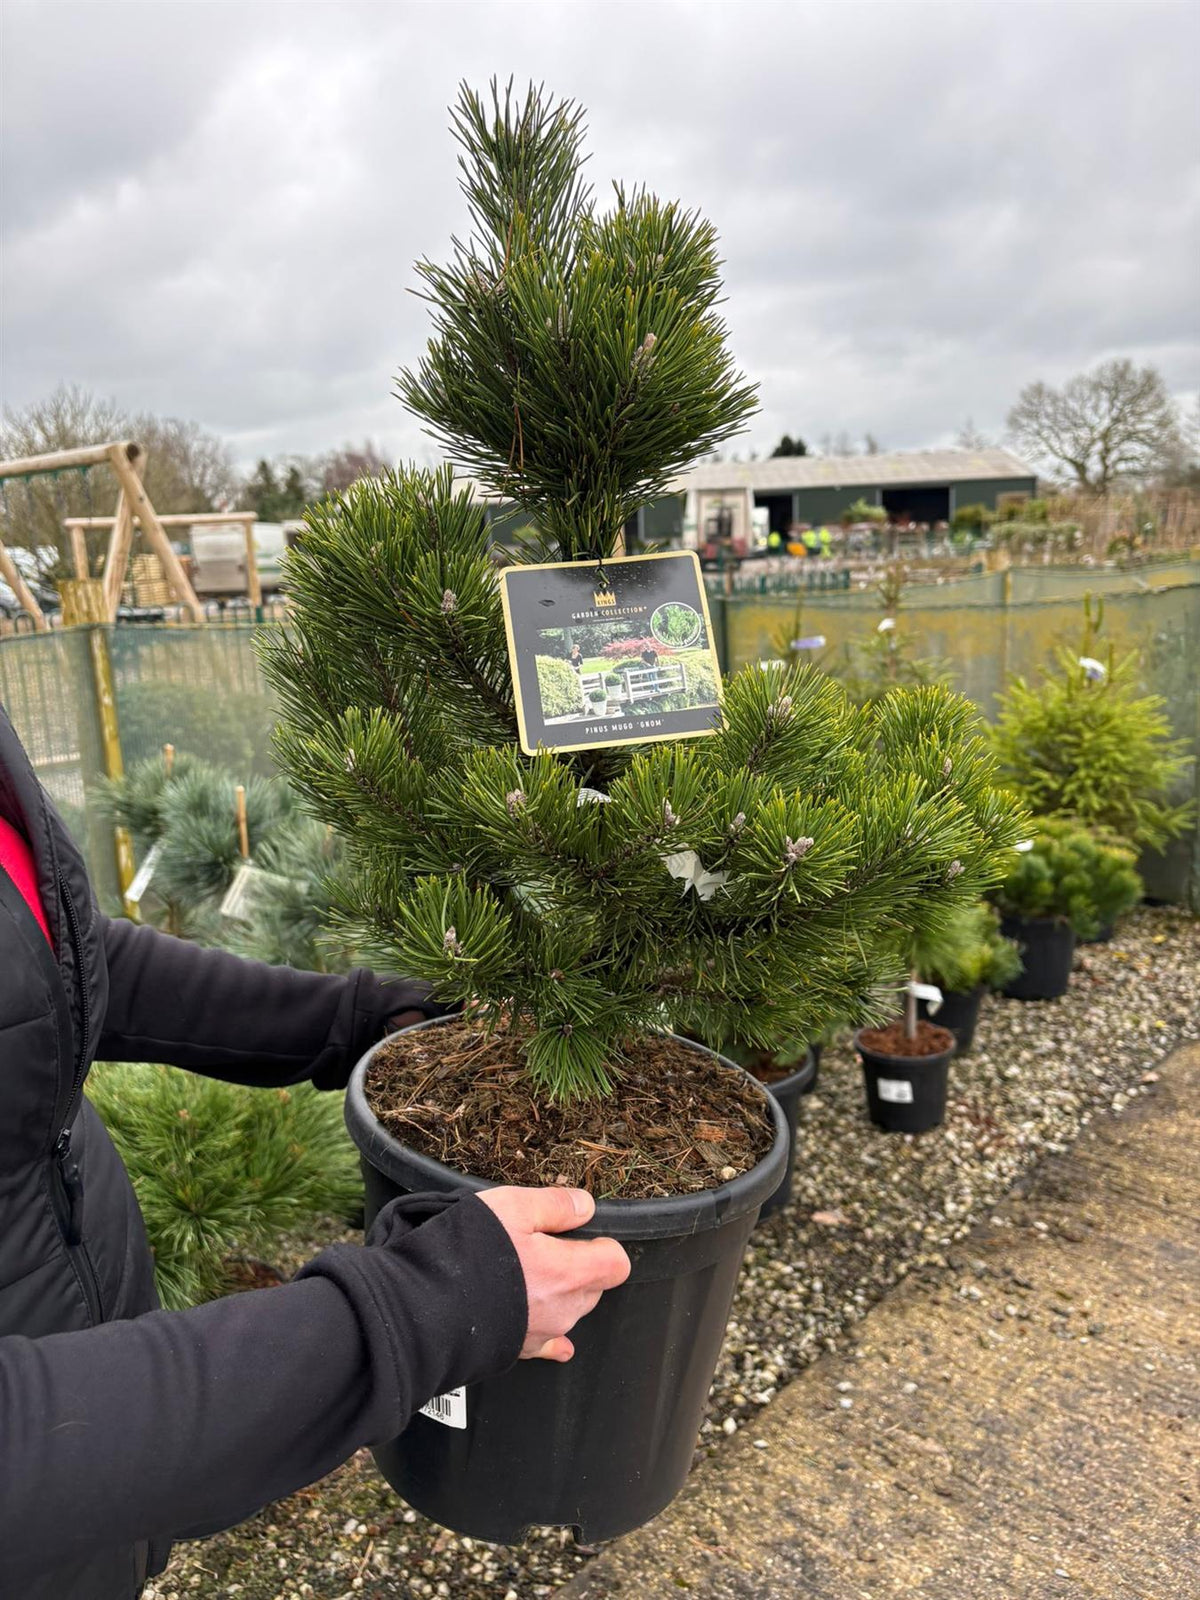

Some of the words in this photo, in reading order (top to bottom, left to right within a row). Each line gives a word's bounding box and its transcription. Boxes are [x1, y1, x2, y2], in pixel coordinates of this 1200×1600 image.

[571, 611, 599, 619] GARDEN
[585, 725, 608, 734] PINUS
[611, 722, 633, 731] MUGO
